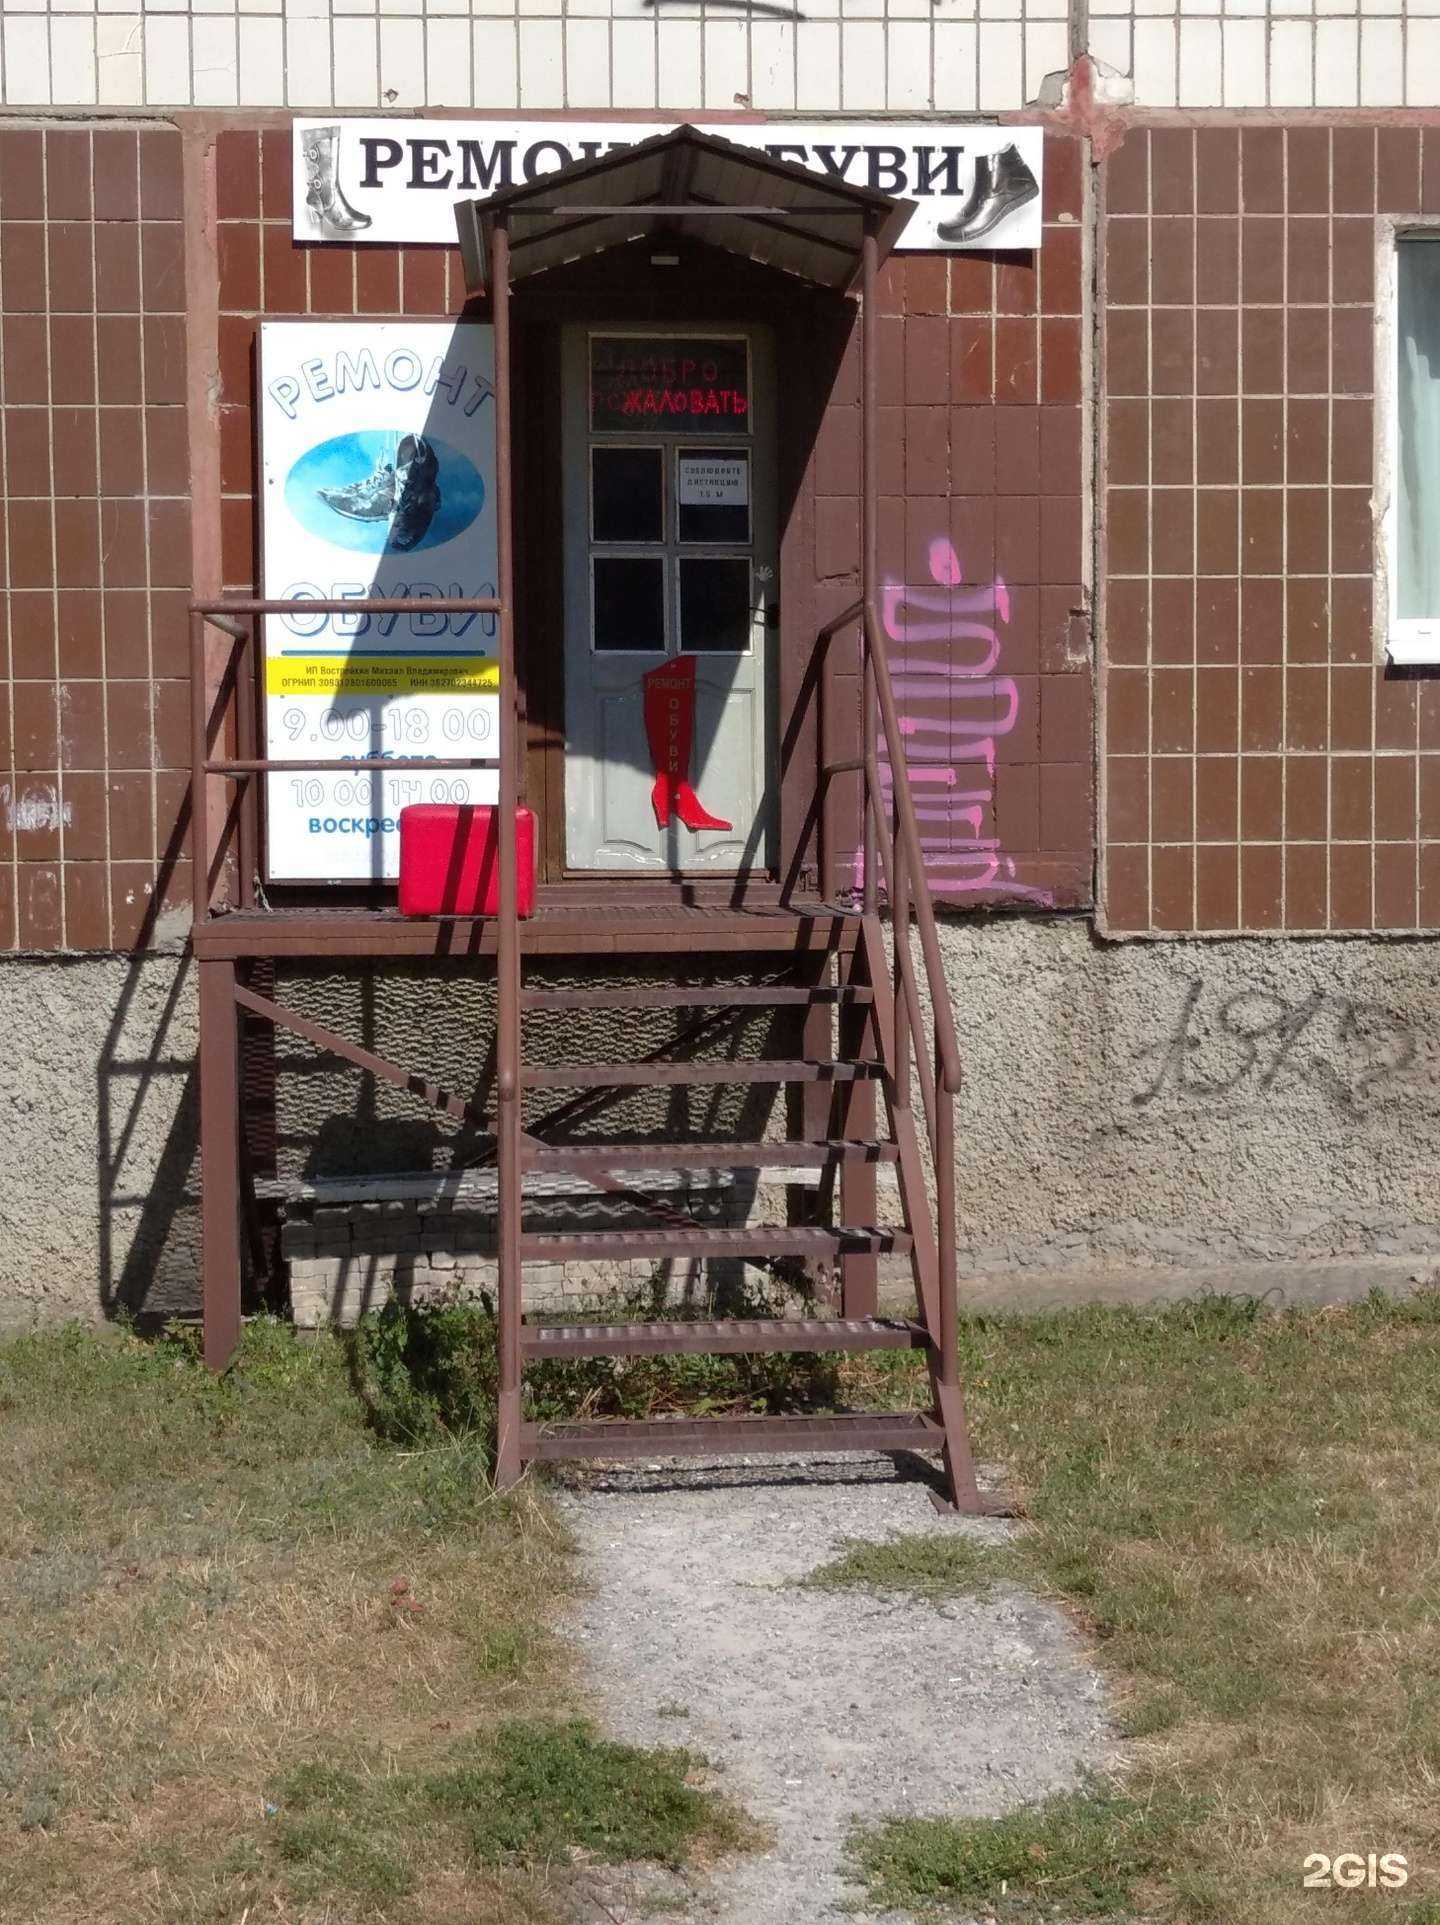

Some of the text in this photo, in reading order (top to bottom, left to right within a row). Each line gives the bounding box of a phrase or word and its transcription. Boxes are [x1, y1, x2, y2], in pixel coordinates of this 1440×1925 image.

[359, 137, 965, 197] РЕМО УВИ
[267, 347, 495, 420] РЕМОНТ
[279, 581, 497, 637] ОБУВИ
[281, 678, 316, 688] ОГРНИП
[305, 666, 318, 675] ИП
[668, 698, 680, 772] ОБУВИ
